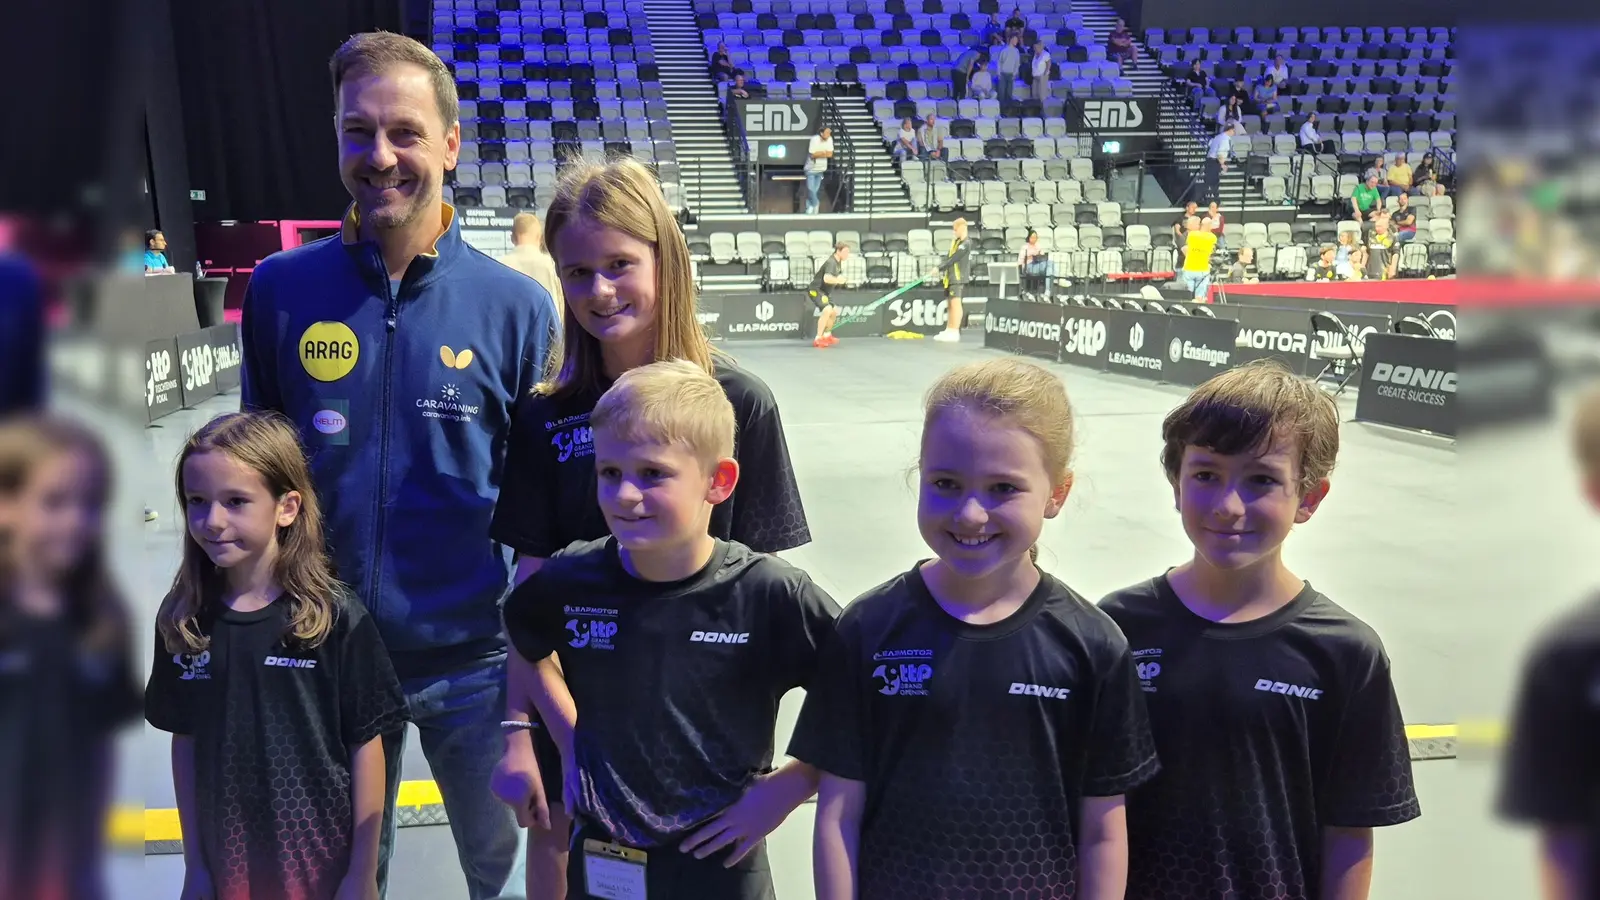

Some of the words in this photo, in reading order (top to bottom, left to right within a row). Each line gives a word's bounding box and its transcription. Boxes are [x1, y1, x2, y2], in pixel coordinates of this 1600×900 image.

[745, 103, 809, 132] EMS
[1083, 100, 1143, 128] EMS
[489, 217, 514, 226] OPENIN
[728, 322, 800, 332] LEAPMOTOR
[305, 341, 353, 360] ARAG
[1183, 340, 1230, 367] Ensinger
[1108, 351, 1162, 370] LEAPMOTOR
[1371, 362, 1458, 393] DONIC
[1377, 384, 1407, 400] CREATE
[1407, 388, 1446, 406] SUCCESS
[416, 398, 478, 415] CARAVANING
[570, 606, 619, 614] LEAPMOTOR
[690, 631, 749, 643] DONIC
[263, 656, 317, 669] DONIC
[1008, 682, 1070, 700] DONIC
[1254, 678, 1324, 700] DONIC
